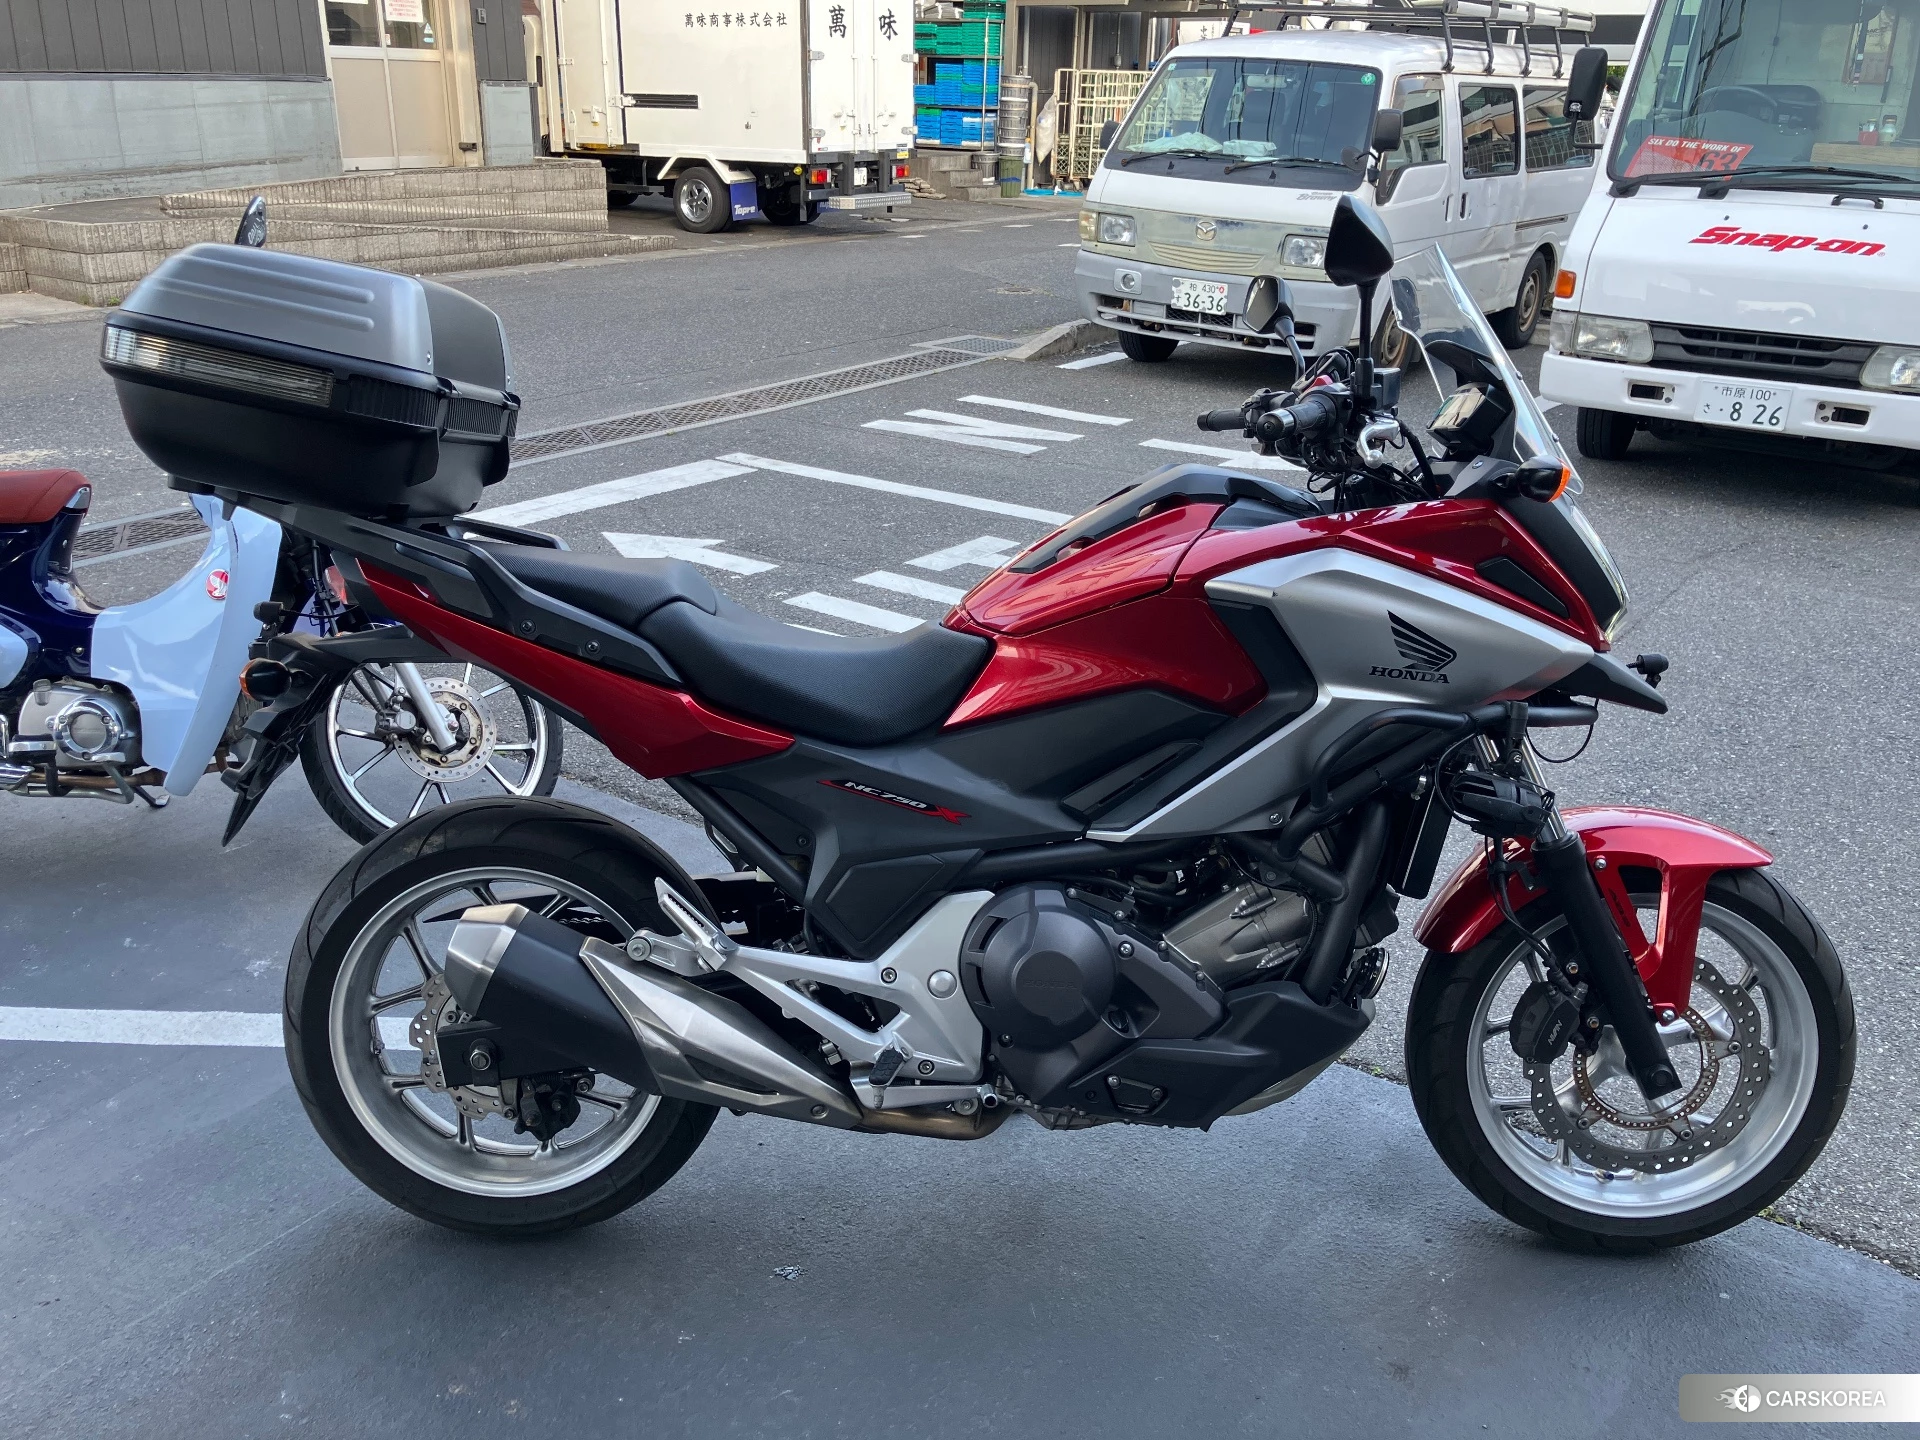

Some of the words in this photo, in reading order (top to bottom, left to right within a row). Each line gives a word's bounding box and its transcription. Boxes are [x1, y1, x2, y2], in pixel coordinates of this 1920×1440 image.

[684, 12, 788, 28] 萬味商事株式会社
[1647, 138, 1666, 146] SIX
[1681, 141, 1701, 149] THE
[1701, 143, 1728, 152] WORK
[734, 204, 756, 216] Topre
[1201, 284, 1216, 294] 430
[1183, 292, 1224, 312] 36-36
[1721, 386, 1747, 399] 市原
[1749, 389, 1772, 401] 100
[1369, 665, 1450, 684] HONDA
